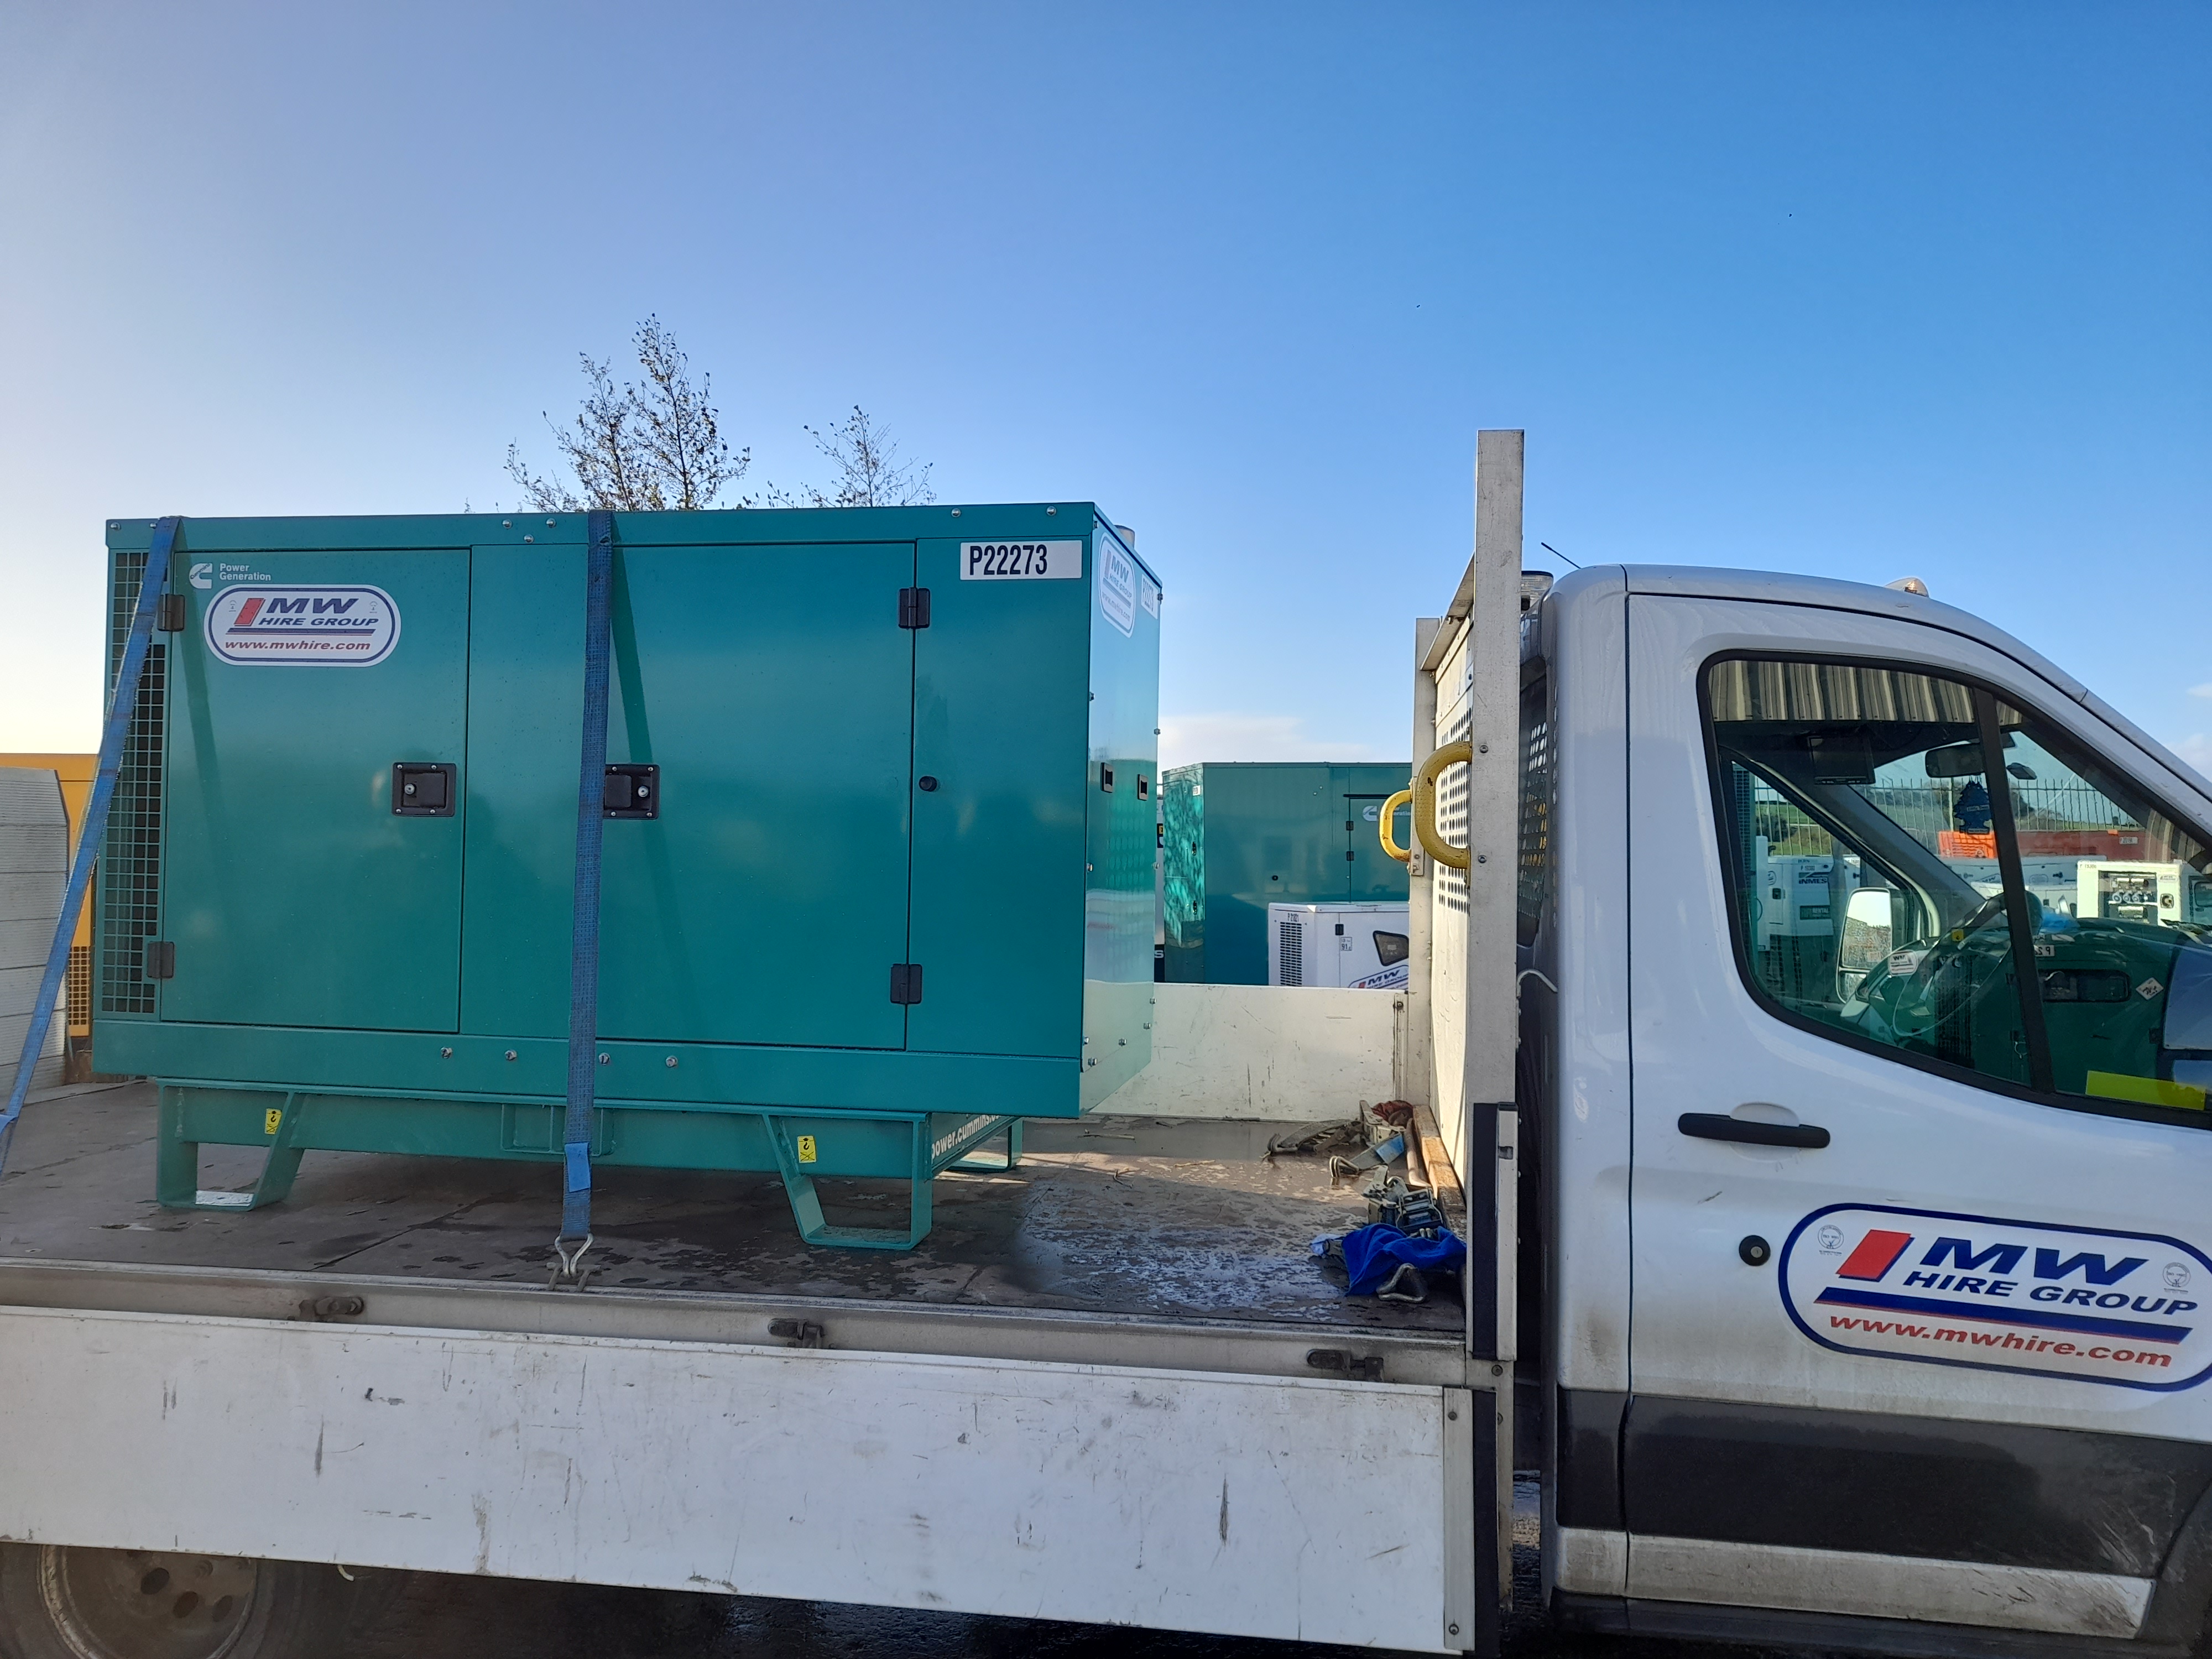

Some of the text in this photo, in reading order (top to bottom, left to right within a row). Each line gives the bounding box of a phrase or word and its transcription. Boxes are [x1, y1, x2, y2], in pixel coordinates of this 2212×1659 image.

[220, 563, 250, 572] Power
[970, 544, 1047, 576] P22273
[219, 572, 272, 581] Generation
[1111, 555, 1129, 583] MW
[266, 598, 359, 614] MW
[258, 617, 379, 627] HIRE GROUP
[225, 640, 371, 650] www.mwhire.com
[1368, 969, 1400, 985] MW
[1919, 1237, 2149, 1286] MW
[1903, 1271, 2198, 1316] HIRE GROUP
[1830, 1315, 2172, 1368] www.mwhire.com
